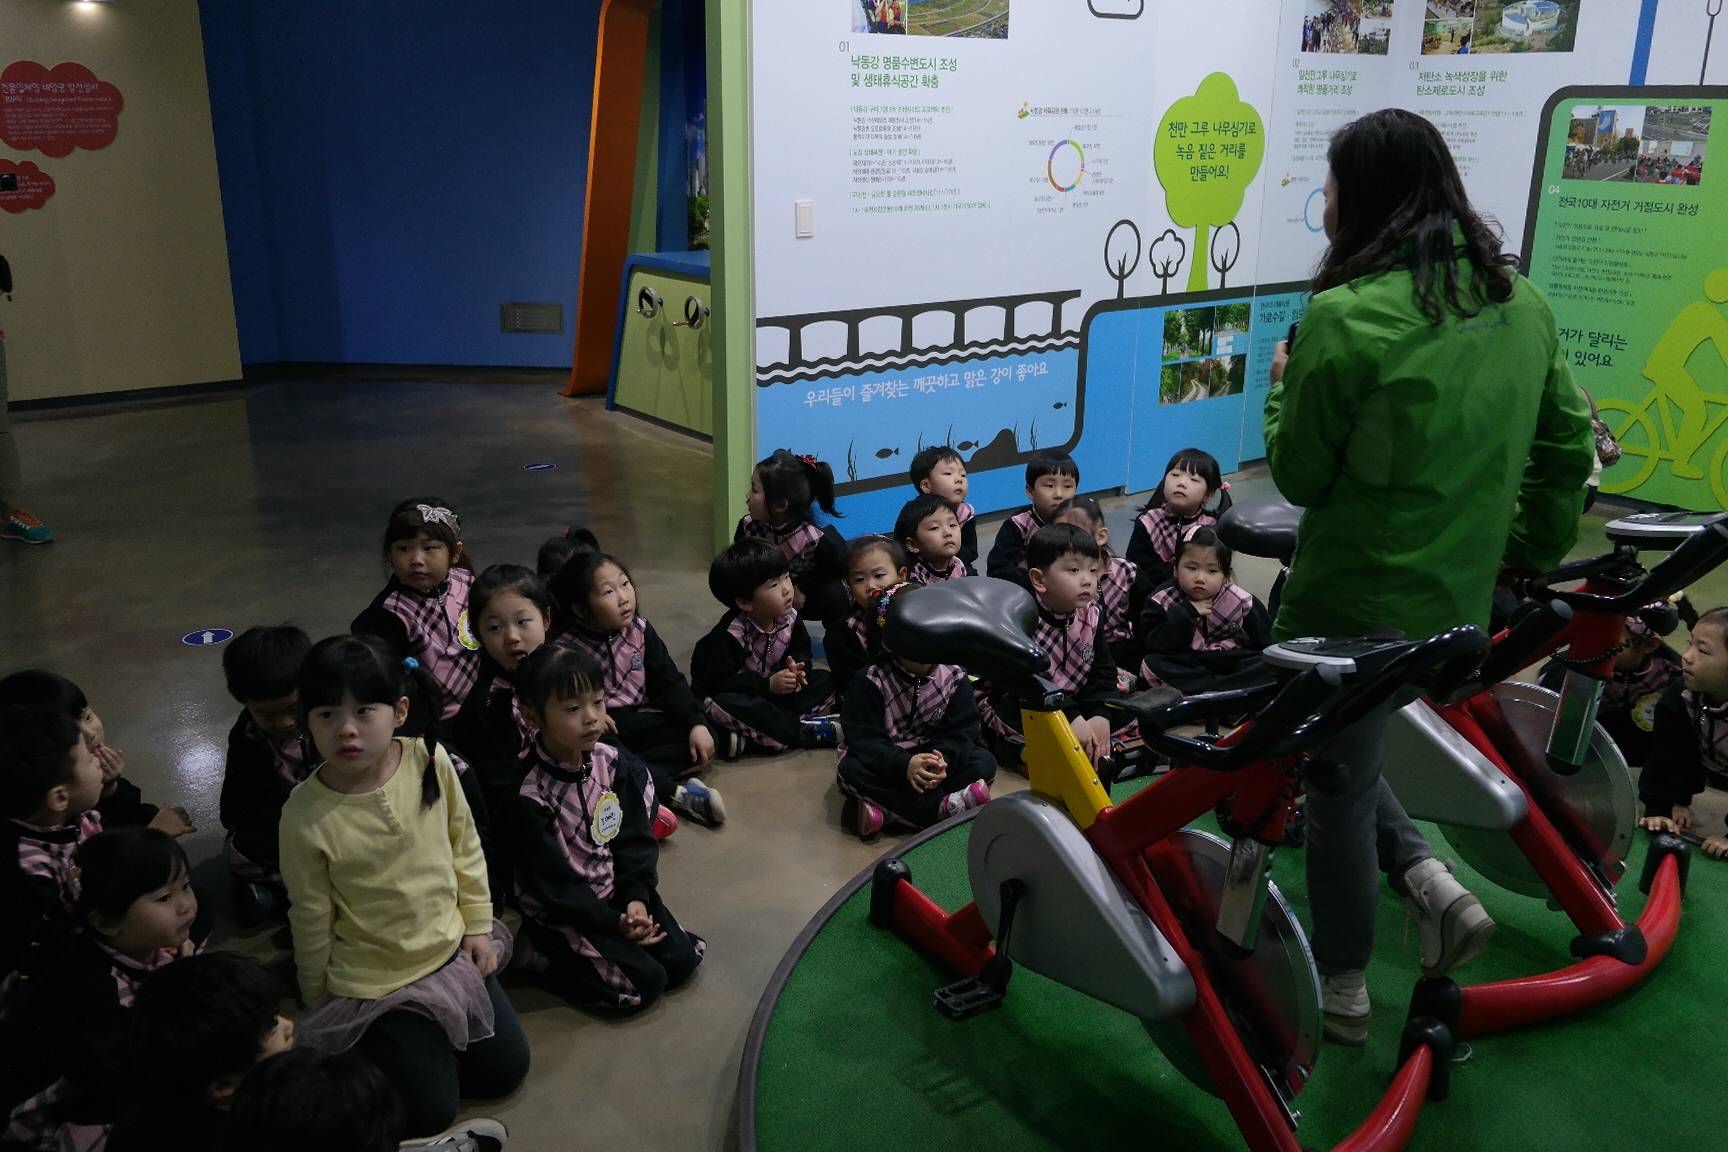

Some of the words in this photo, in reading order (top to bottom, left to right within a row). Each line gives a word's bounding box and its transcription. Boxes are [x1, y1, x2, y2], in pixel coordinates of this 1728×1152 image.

[838, 41, 850, 52] 01
[851, 55, 880, 70] 낙동강
[882, 56, 937, 71] 명품수변도시
[939, 58, 957, 72] 조성
[851, 74, 860, 87] 및
[864, 74, 918, 88] 생태휴식공간
[921, 75, 939, 89] 확충
[1418, 72, 1442, 82] 저탄소
[1445, 71, 1487, 82] 녹색성장을
[1490, 70, 1508, 82] 위한
[1341, 85, 1352, 96] 조성
[1417, 85, 1466, 96] 탄소제로도시
[1468, 85, 1486, 96] 조성
[1168, 121, 1187, 138] 천만
[1190, 122, 1209, 136] 그루
[1213, 121, 1256, 138] 나무심기로
[1175, 144, 1195, 160] 녹음
[1198, 143, 1216, 160] 짙은
[1220, 143, 1246, 159] 거리를
[1190, 165, 1230, 182] 만들어요!
[1548, 185, 1560, 195] 04
[1558, 196, 1598, 210] 전국10대
[1600, 199, 1631, 212] 자전거
[1634, 201, 1674, 214] 거점도시
[1677, 203, 1699, 216] 완성
[1259, 310, 1286, 323] 가로수길
[1588, 332, 1628, 351] 달리는
[1575, 351, 1613, 367] 있어요
[804, 386, 856, 408] 우리들이
[860, 381, 910, 402] 즐겨찾는
[912, 373, 960, 394] 깨끗하고
[964, 369, 987, 389] 맑은
[990, 366, 1013, 385] 강이
[1016, 362, 1049, 382] 좋아요
